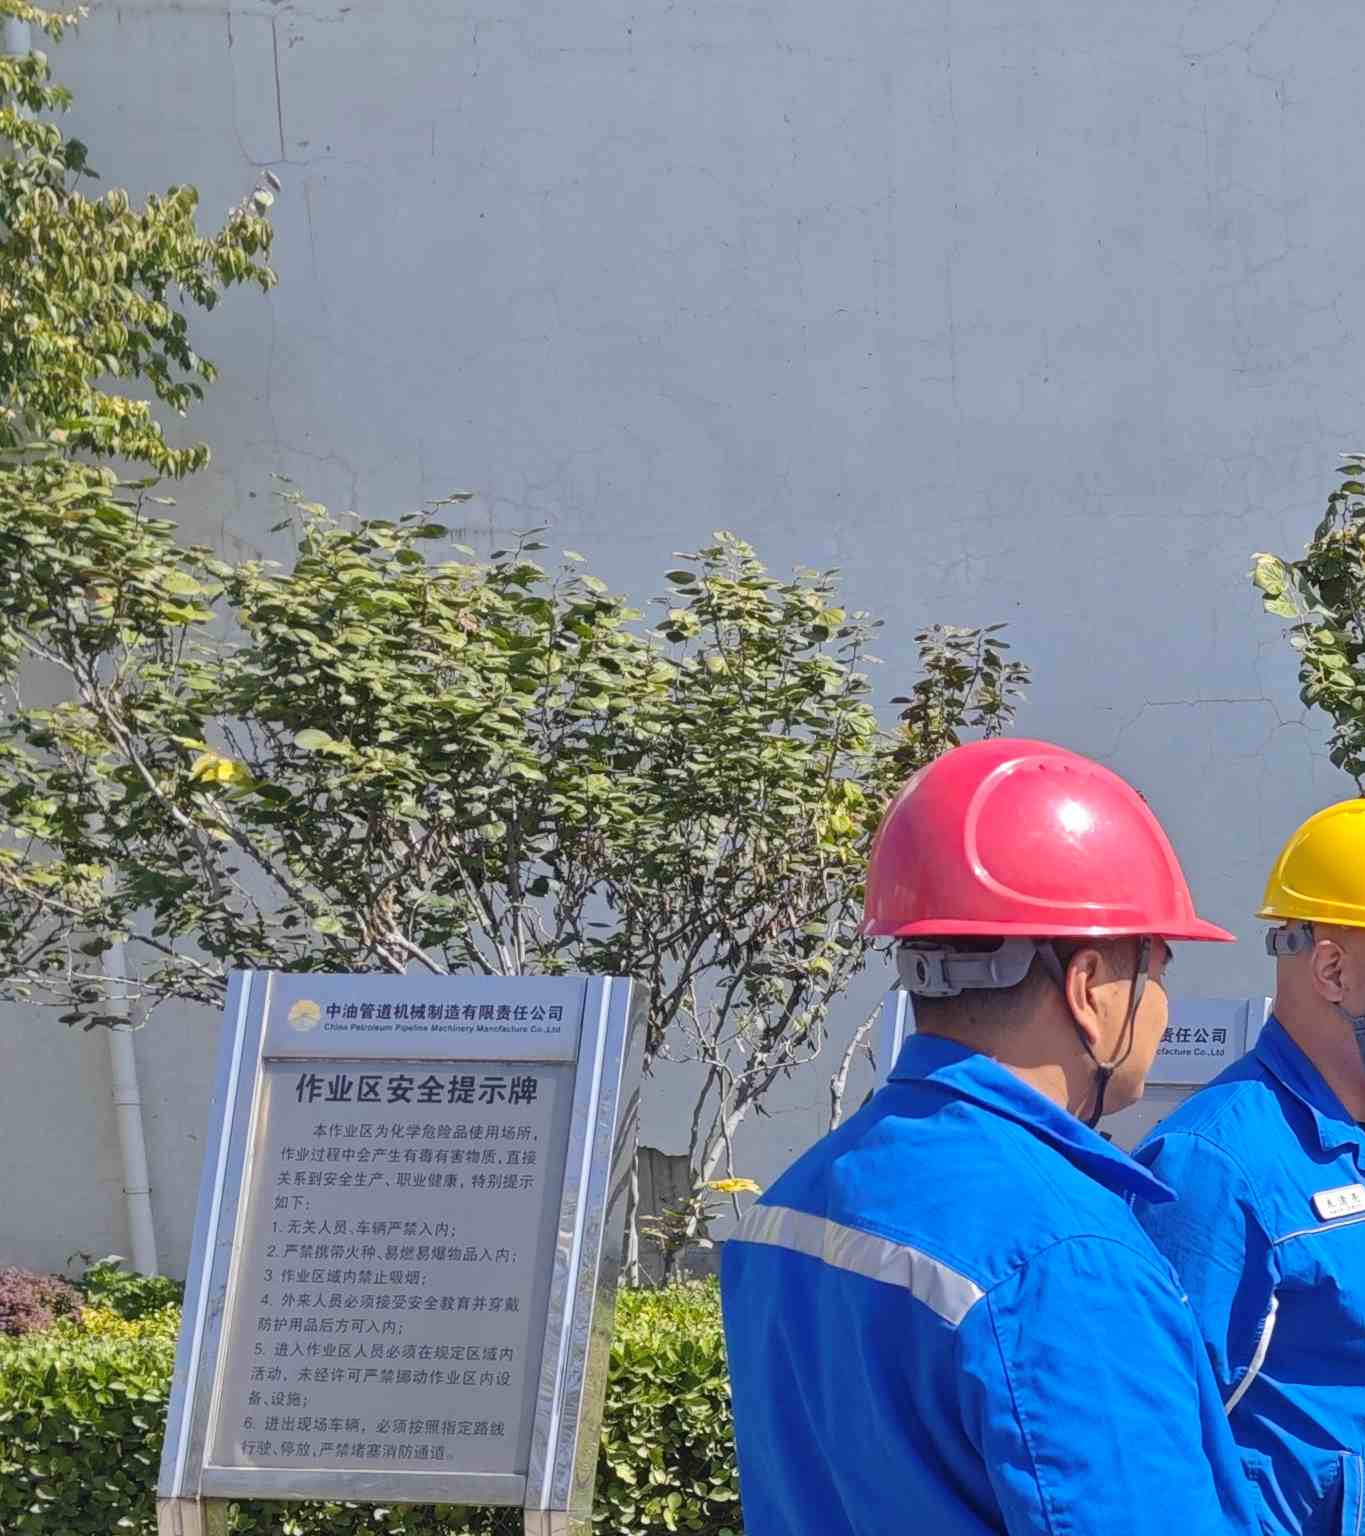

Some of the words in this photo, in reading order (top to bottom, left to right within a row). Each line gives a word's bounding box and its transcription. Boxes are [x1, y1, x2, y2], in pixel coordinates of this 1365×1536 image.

[325, 1001, 564, 1022] 中油管道机械制造有限责任公司
[323, 1022, 349, 1032] China
[350, 1022, 394, 1032] Petroleum
[395, 1023, 429, 1034] Pipeline
[430, 1023, 475, 1036] Machinery
[295, 1074, 538, 1105] 作业区安全提示牌
